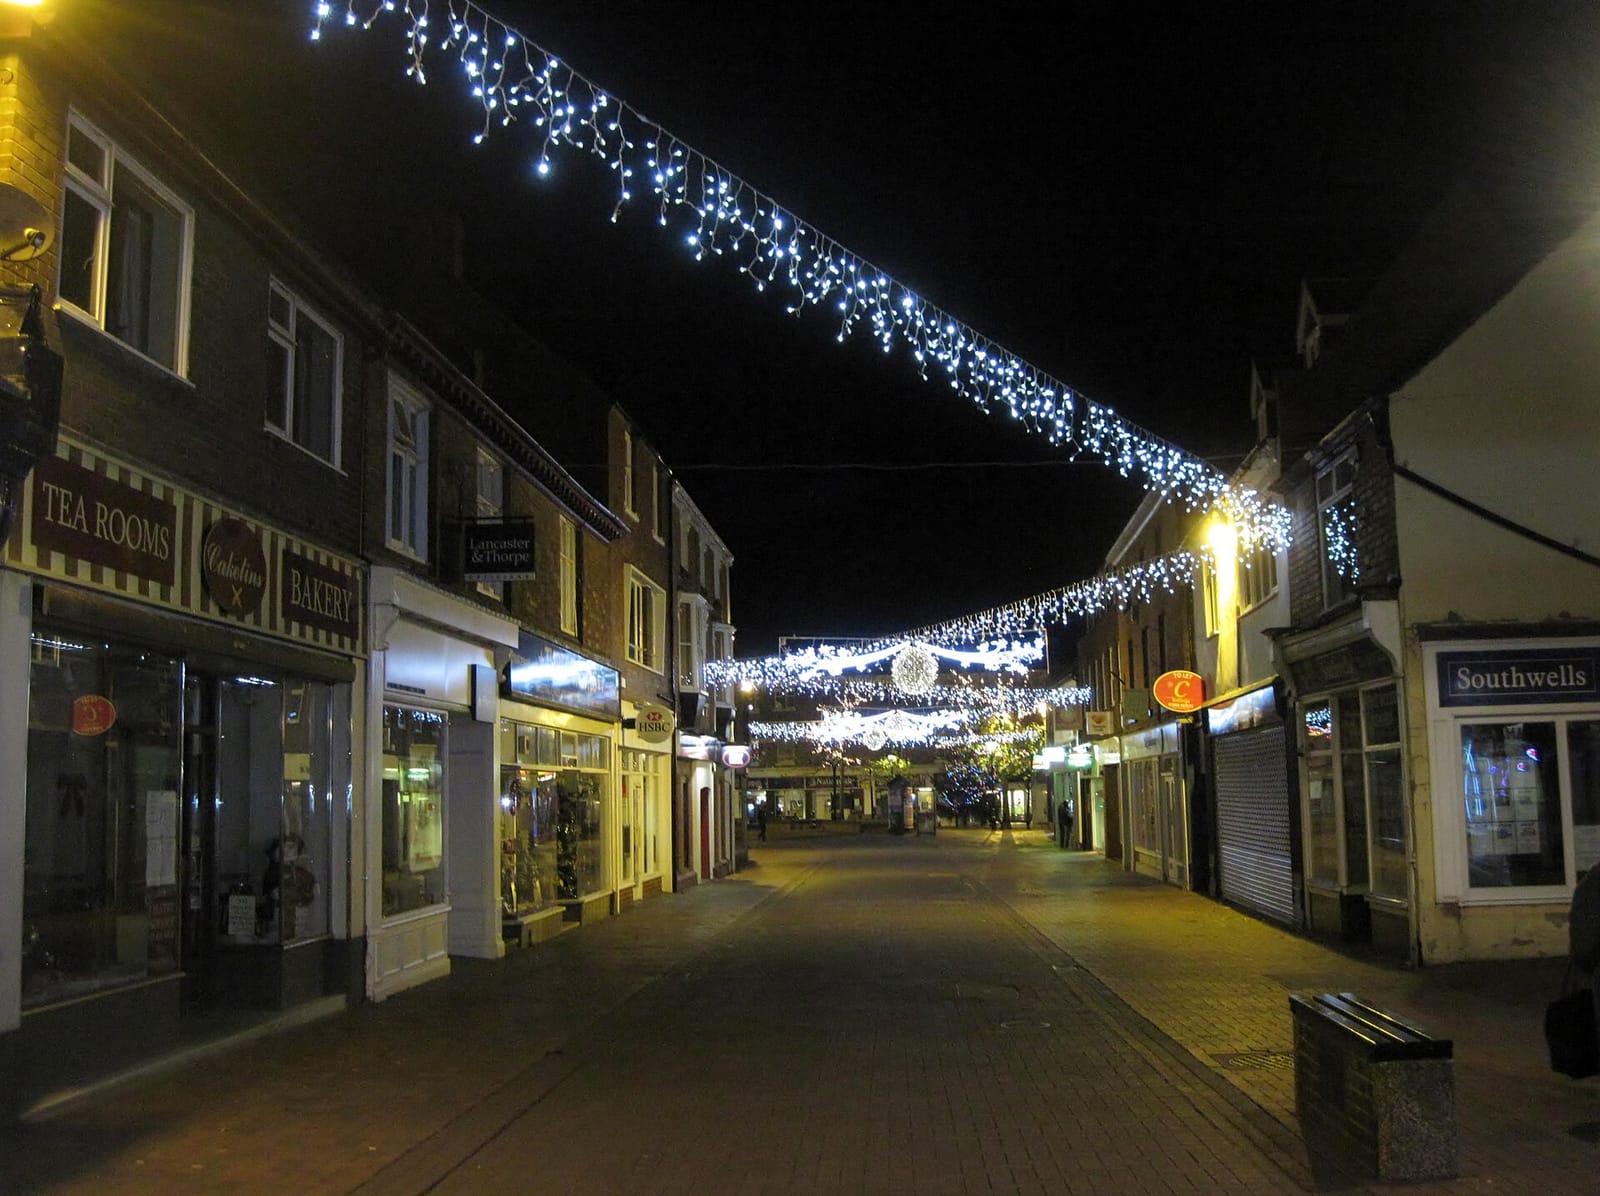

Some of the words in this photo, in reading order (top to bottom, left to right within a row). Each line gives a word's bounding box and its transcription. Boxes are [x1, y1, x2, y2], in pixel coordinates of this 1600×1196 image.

[43, 481, 89, 534] TEA
[94, 501, 169, 560] ROOMS
[468, 537, 531, 550] Lancaster
[291, 568, 352, 624] BAKERY
[1182, 672, 1194, 680] LET
[1457, 664, 1587, 690] Southwells
[639, 722, 671, 732] HSBC
